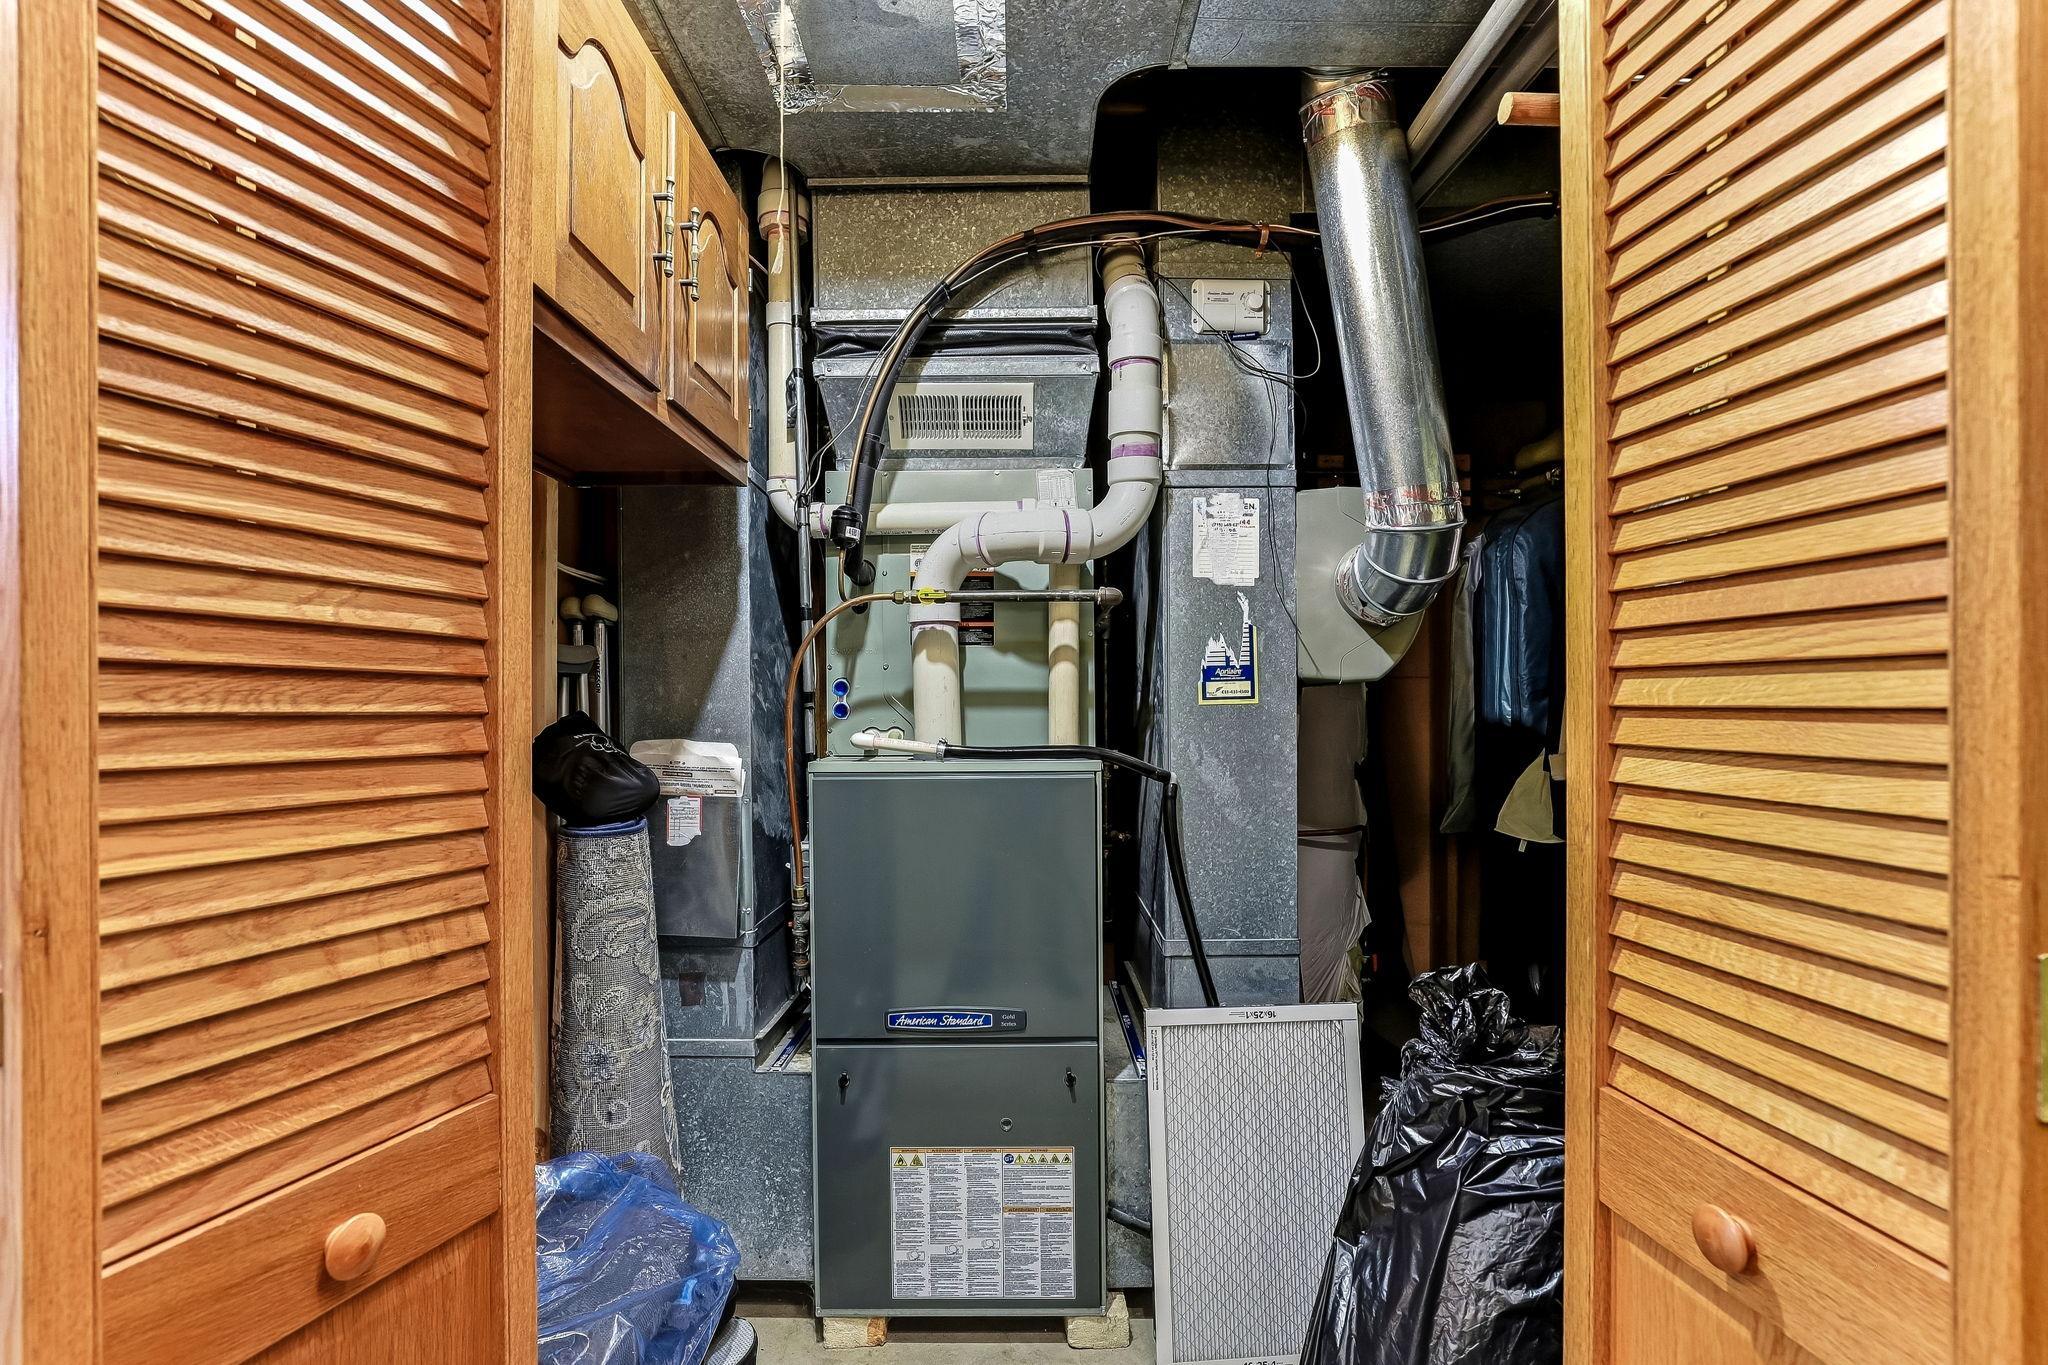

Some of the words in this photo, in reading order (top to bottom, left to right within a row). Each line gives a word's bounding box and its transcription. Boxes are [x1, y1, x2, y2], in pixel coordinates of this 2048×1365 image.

[1245, 1010, 1277, 1019] 16x25x1
[895, 1014, 937, 1026] American
[939, 1014, 986, 1026] Standard
